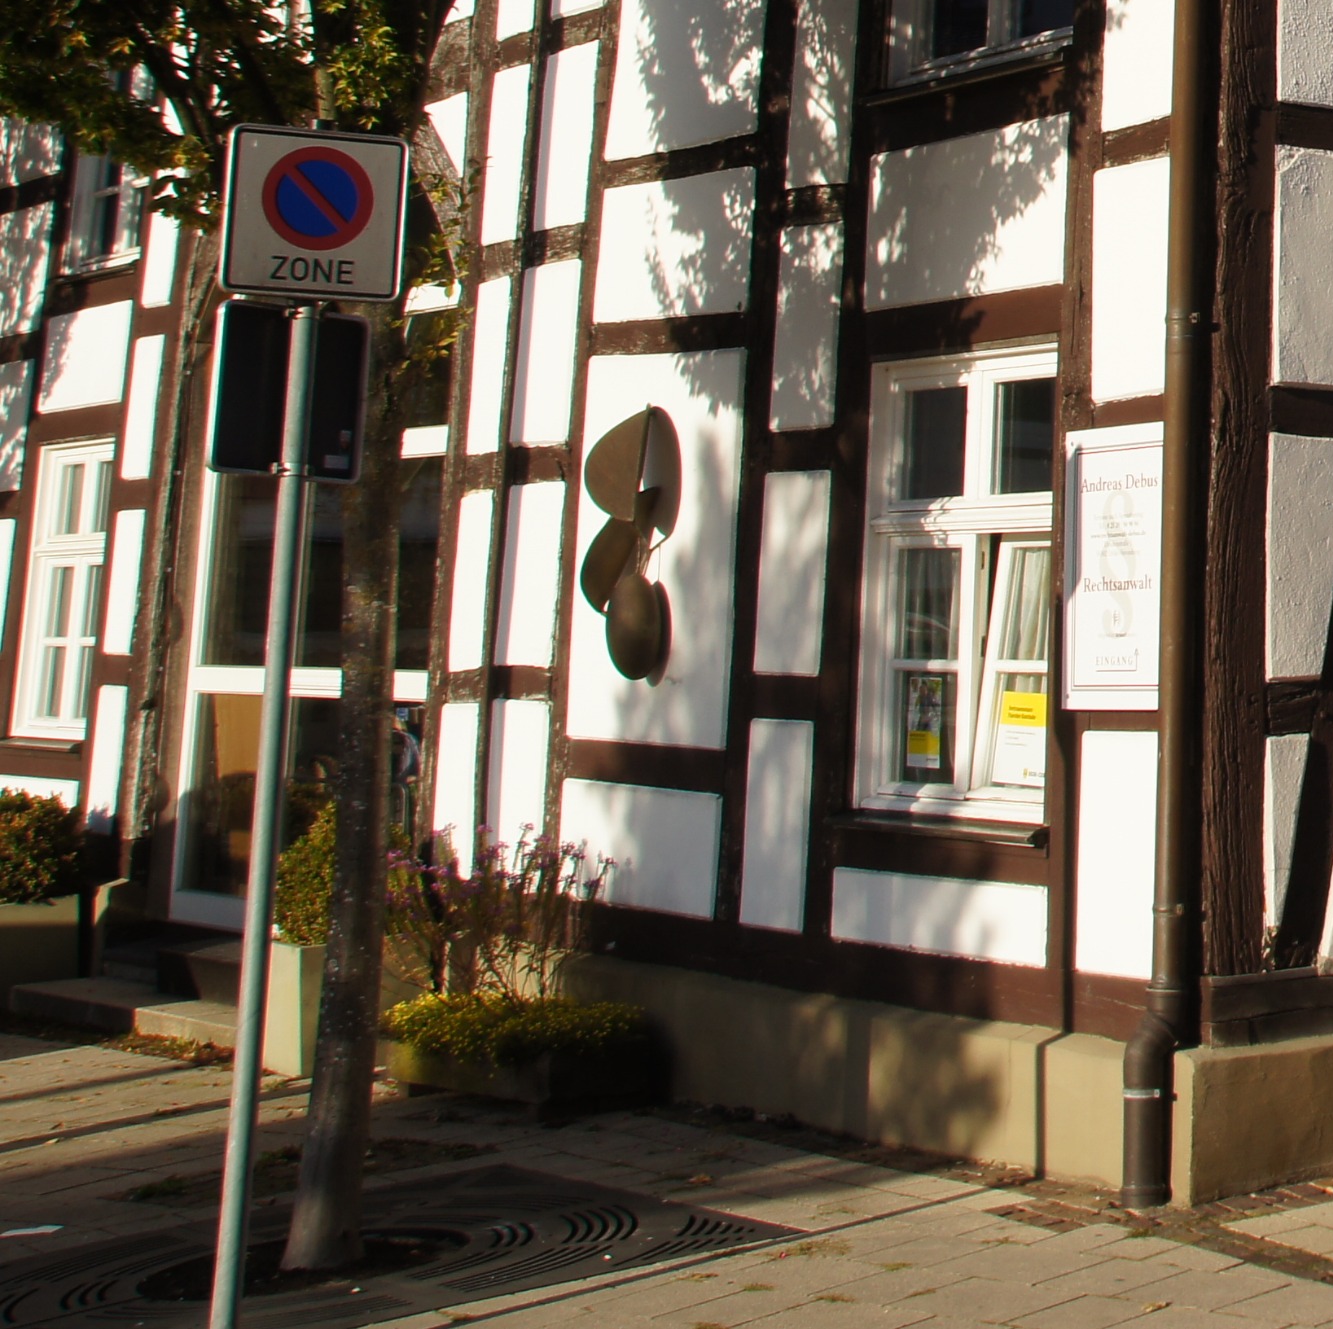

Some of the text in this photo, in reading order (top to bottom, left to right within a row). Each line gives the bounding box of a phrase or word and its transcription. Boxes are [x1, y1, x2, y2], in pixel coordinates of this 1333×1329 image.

[270, 255, 356, 285] ZONE
[1080, 472, 1158, 494] Andreas Debus
[1083, 573, 1152, 593] Rechtsanwalt
[1095, 655, 1133, 667] EINGANG
